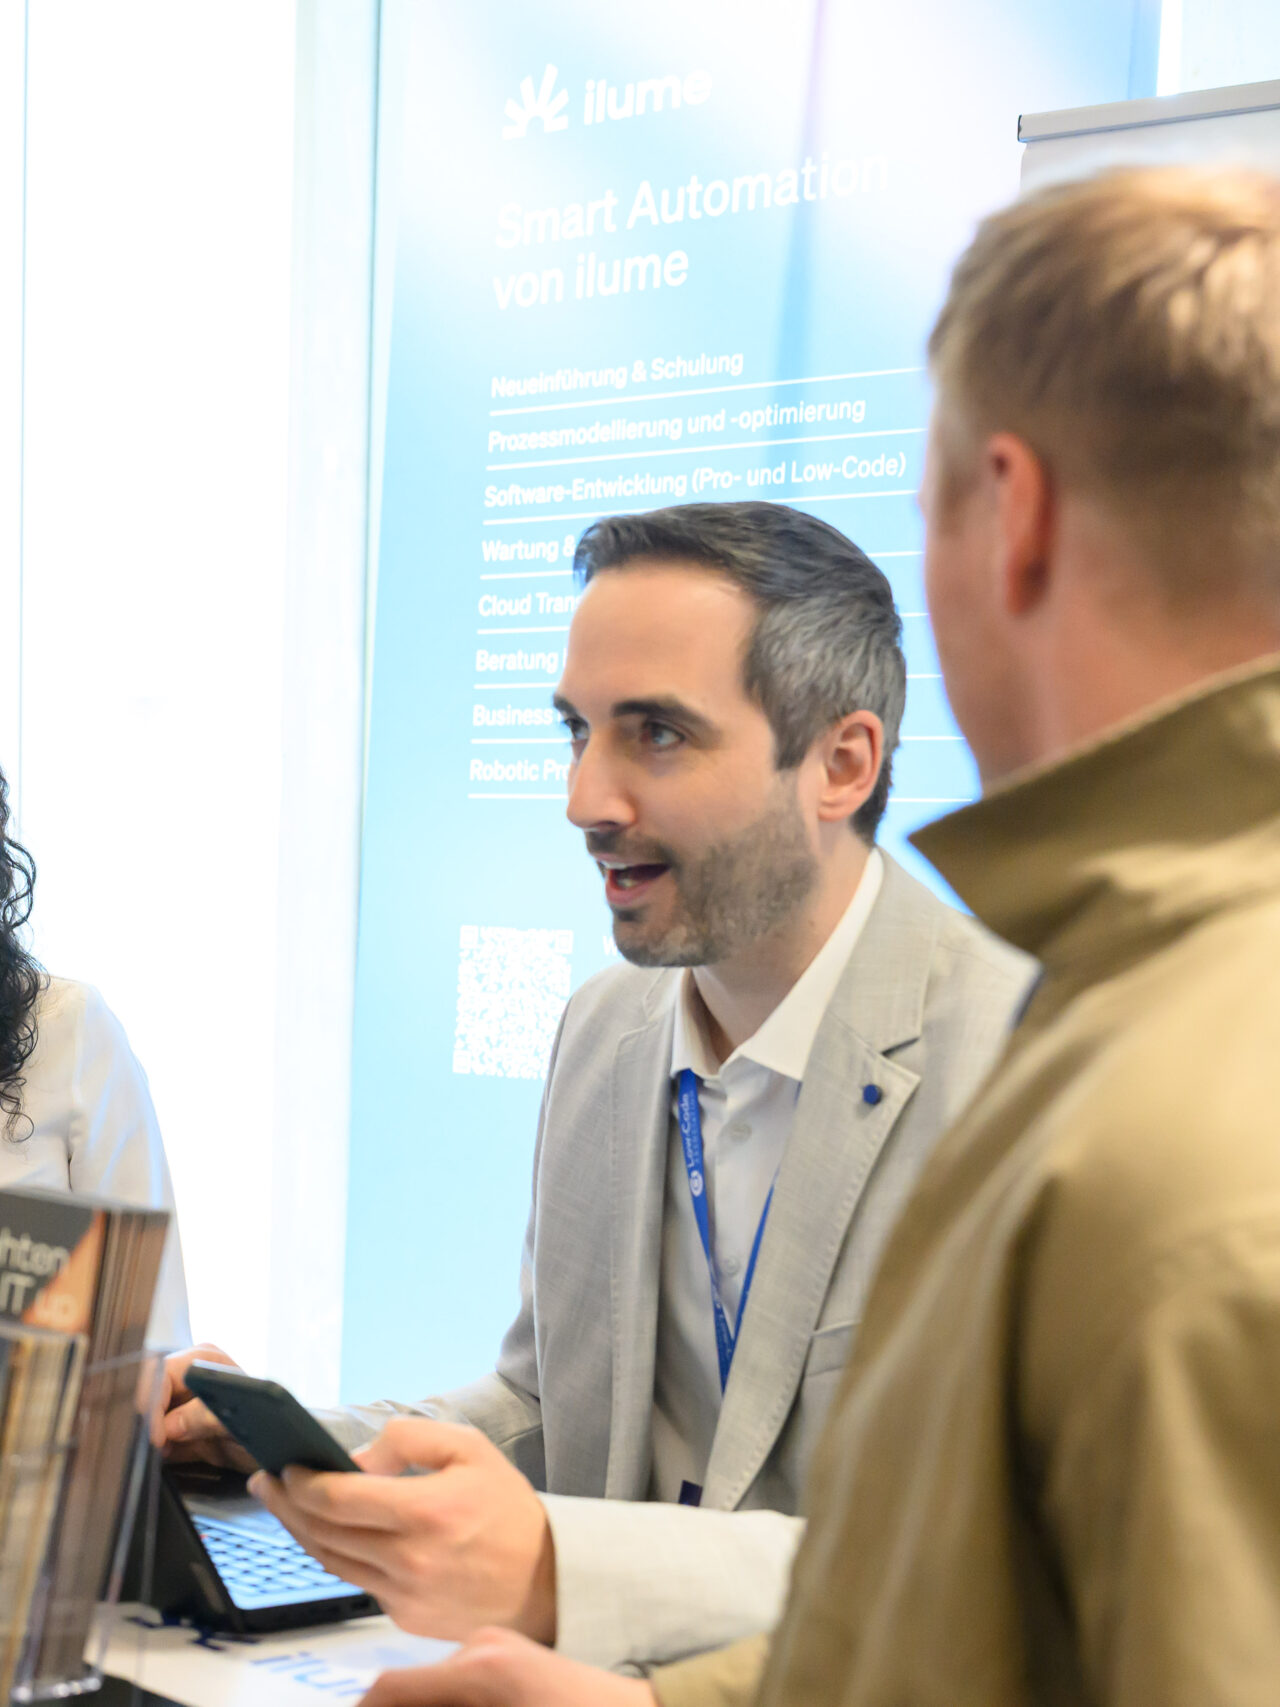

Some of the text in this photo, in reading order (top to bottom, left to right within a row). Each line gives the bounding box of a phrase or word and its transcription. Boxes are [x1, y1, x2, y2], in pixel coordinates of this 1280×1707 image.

[584, 68, 713, 125] ilume
[495, 152, 889, 249] Smart Automation
[492, 249, 689, 311] von ilume
[490, 353, 744, 399] Neueinführung & Schulung
[488, 399, 866, 453] Prozessmodellierung und -optimierung
[484, 452, 907, 508] Software-Entwicklung (Pro- und Low-Code)
[481, 535, 576, 562] Wartung &
[478, 593, 531, 616] Cloud
[475, 649, 559, 673] Beratung
[472, 704, 553, 727] Business
[469, 759, 540, 782] Robotic
